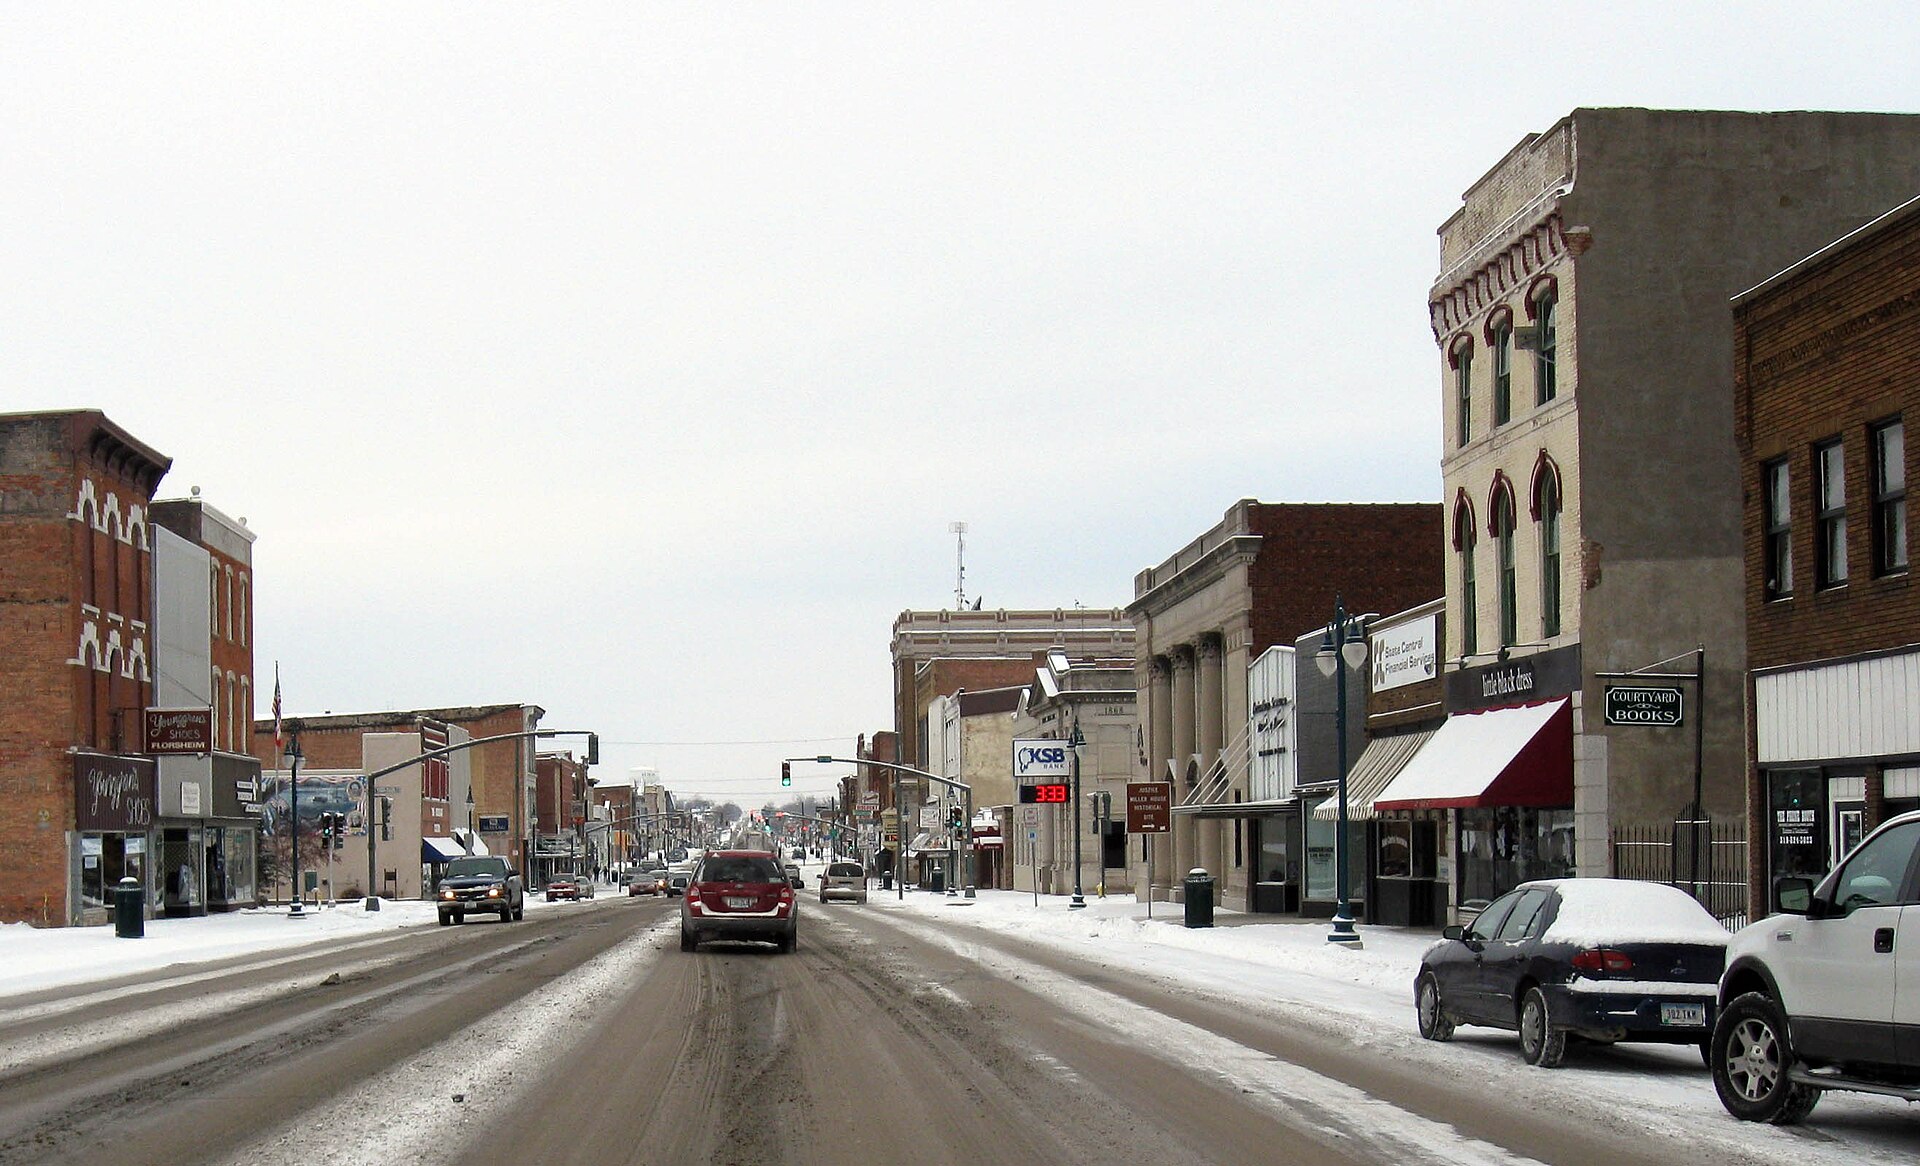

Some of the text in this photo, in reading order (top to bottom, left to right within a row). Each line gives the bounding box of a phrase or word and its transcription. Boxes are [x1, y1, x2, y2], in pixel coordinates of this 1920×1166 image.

[1385, 636, 1424, 659] State Central
[1385, 652, 1435, 674] Financial Services
[1482, 666, 1533, 697] little black dress
[1612, 690, 1676, 703] COURTYARD
[1615, 709, 1675, 721] BOOKS
[169, 729, 201, 739] SHOES
[151, 741, 205, 749] FLORSHEIM
[1029, 747, 1066, 763] KSB
[1035, 785, 1067, 802] 3:33
[127, 796, 151, 826] SHOES
